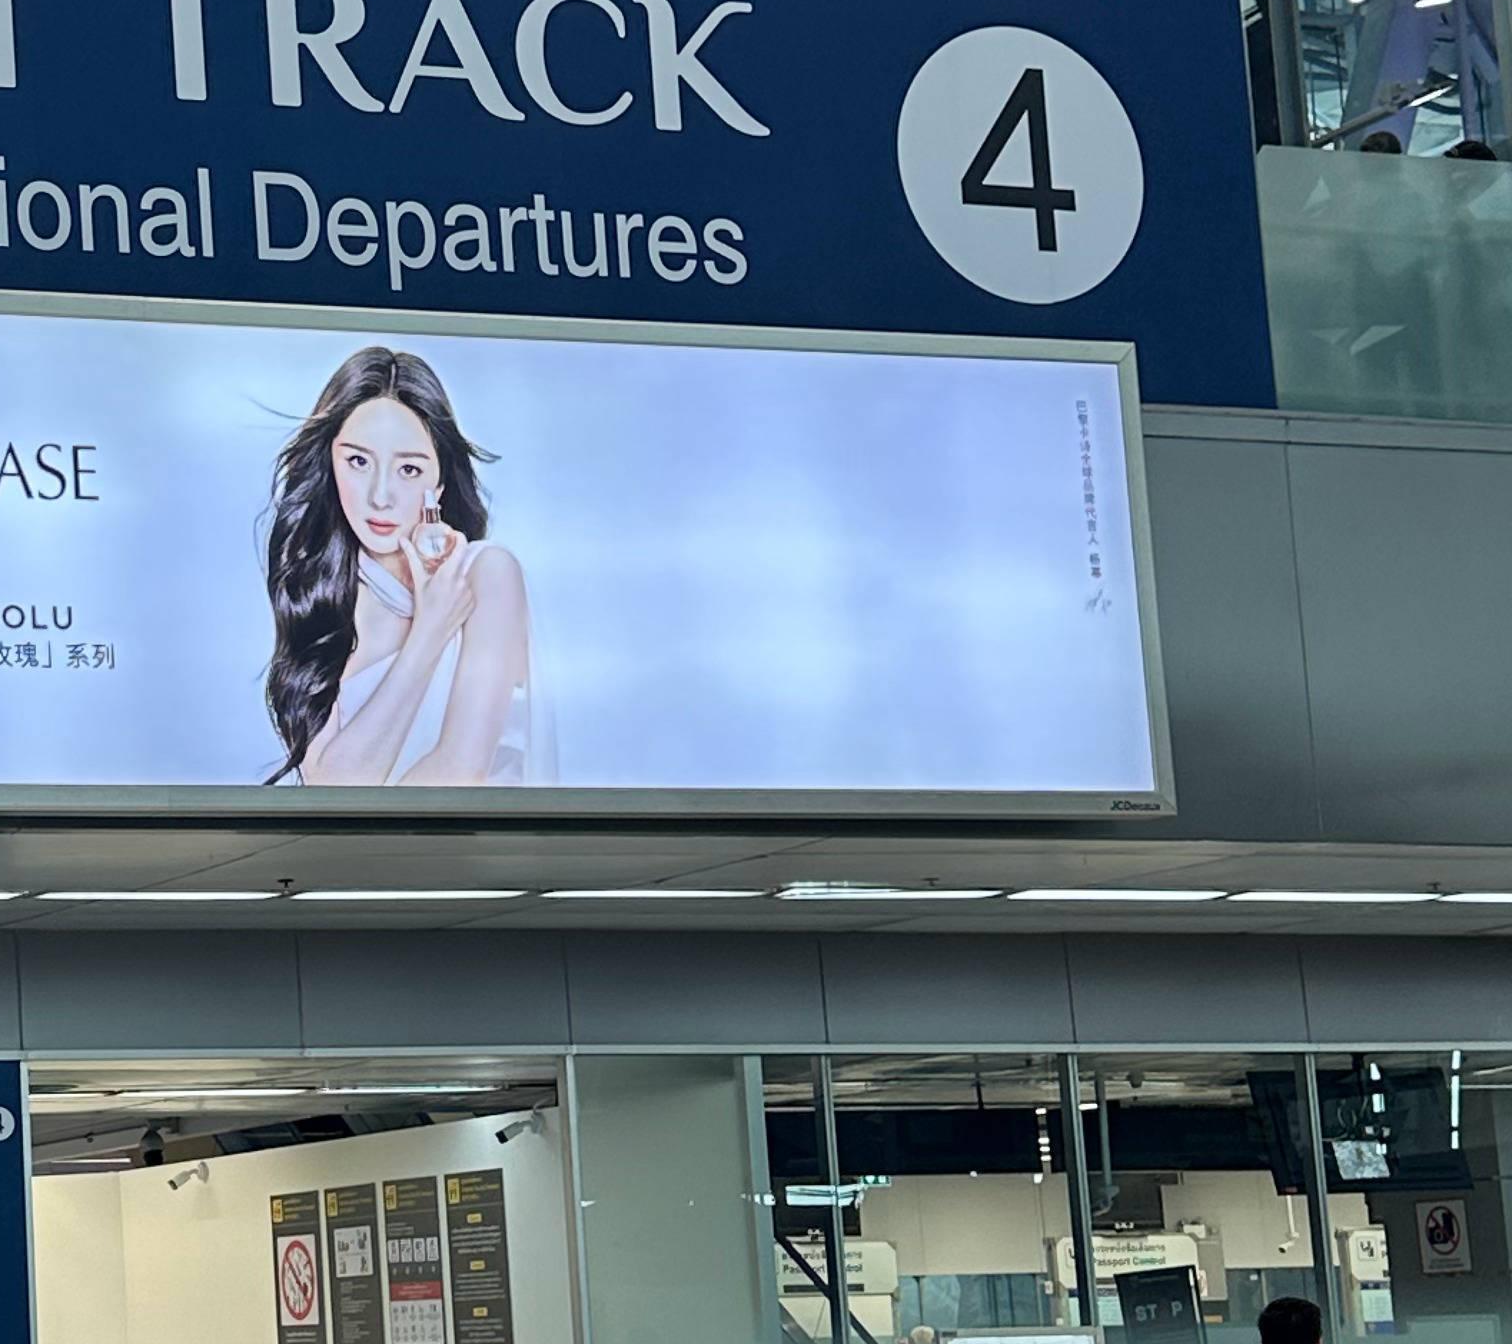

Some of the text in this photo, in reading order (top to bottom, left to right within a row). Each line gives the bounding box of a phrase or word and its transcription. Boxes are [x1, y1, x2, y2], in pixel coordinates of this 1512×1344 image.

[961, 68, 1076, 252] 4
[252, 169, 748, 291] Departures
[1135, 1301, 1183, 1321] STP
